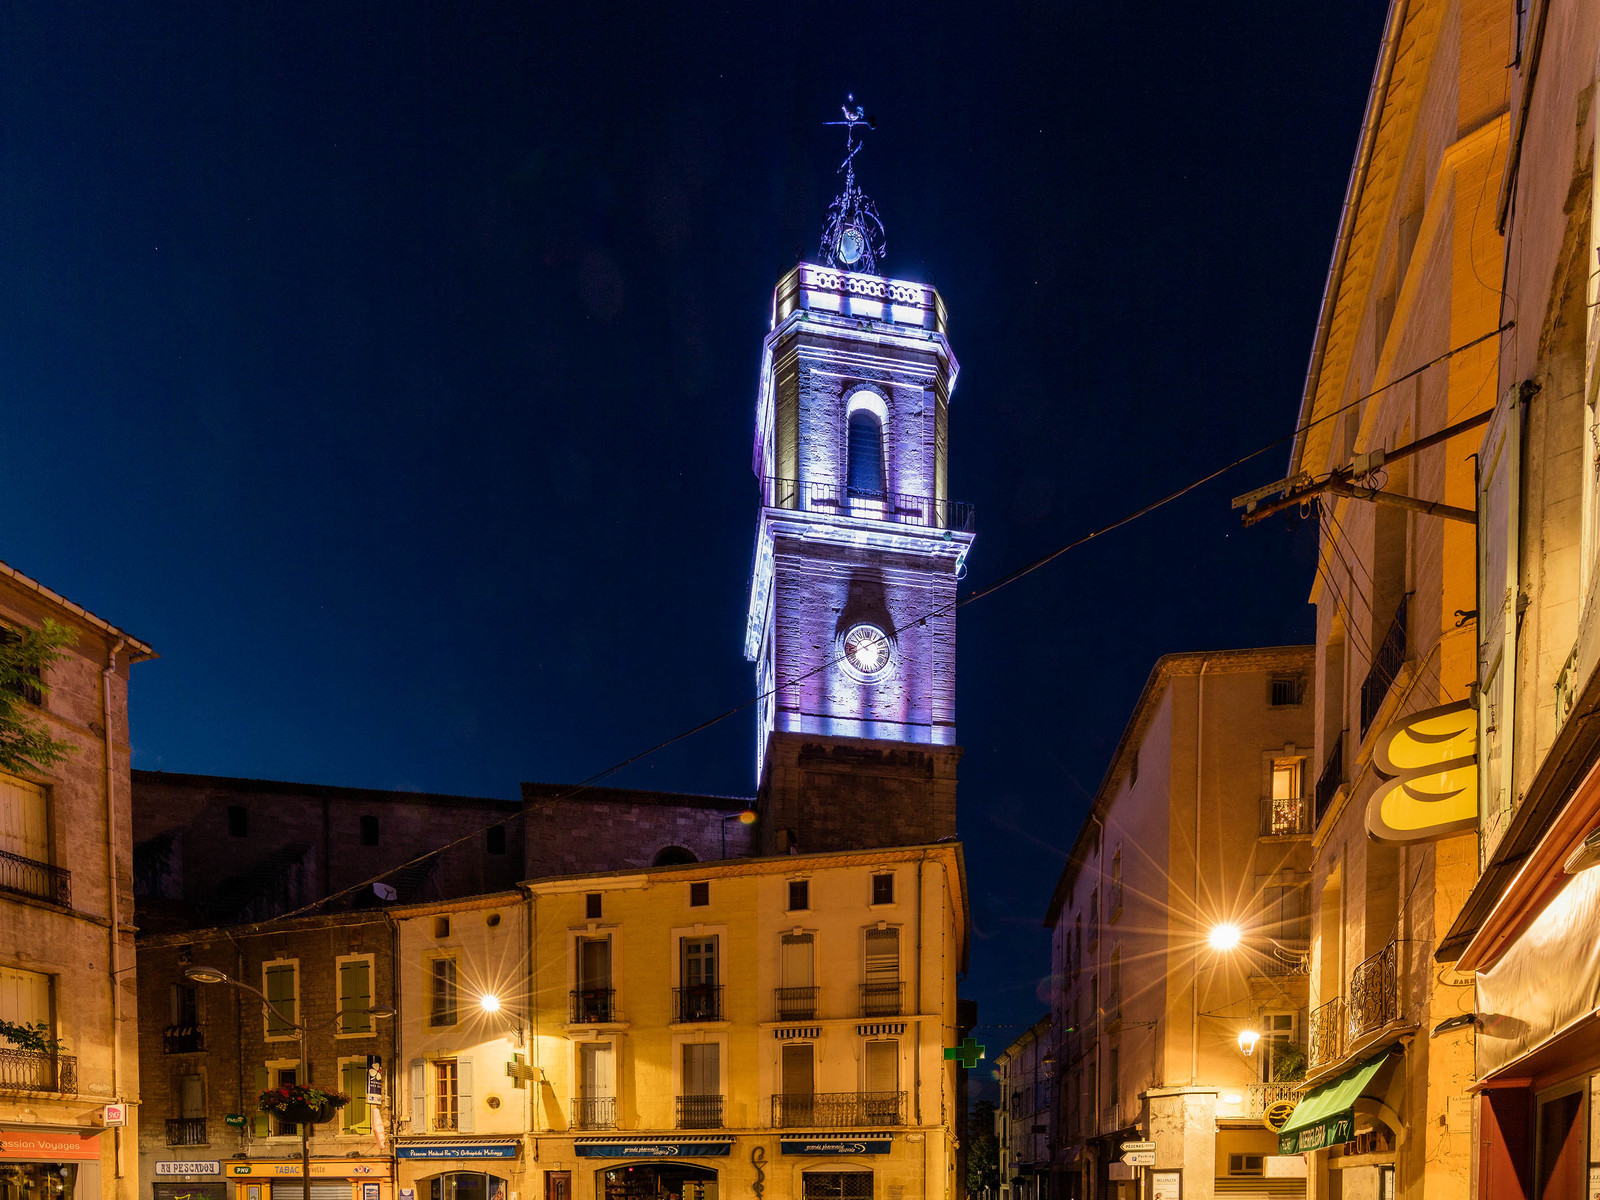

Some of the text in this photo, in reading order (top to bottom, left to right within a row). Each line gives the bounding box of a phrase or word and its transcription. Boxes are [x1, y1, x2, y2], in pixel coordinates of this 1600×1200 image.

[0, 1140, 81, 1151] assion Voyages
[275, 1166, 299, 1174] TABAC
